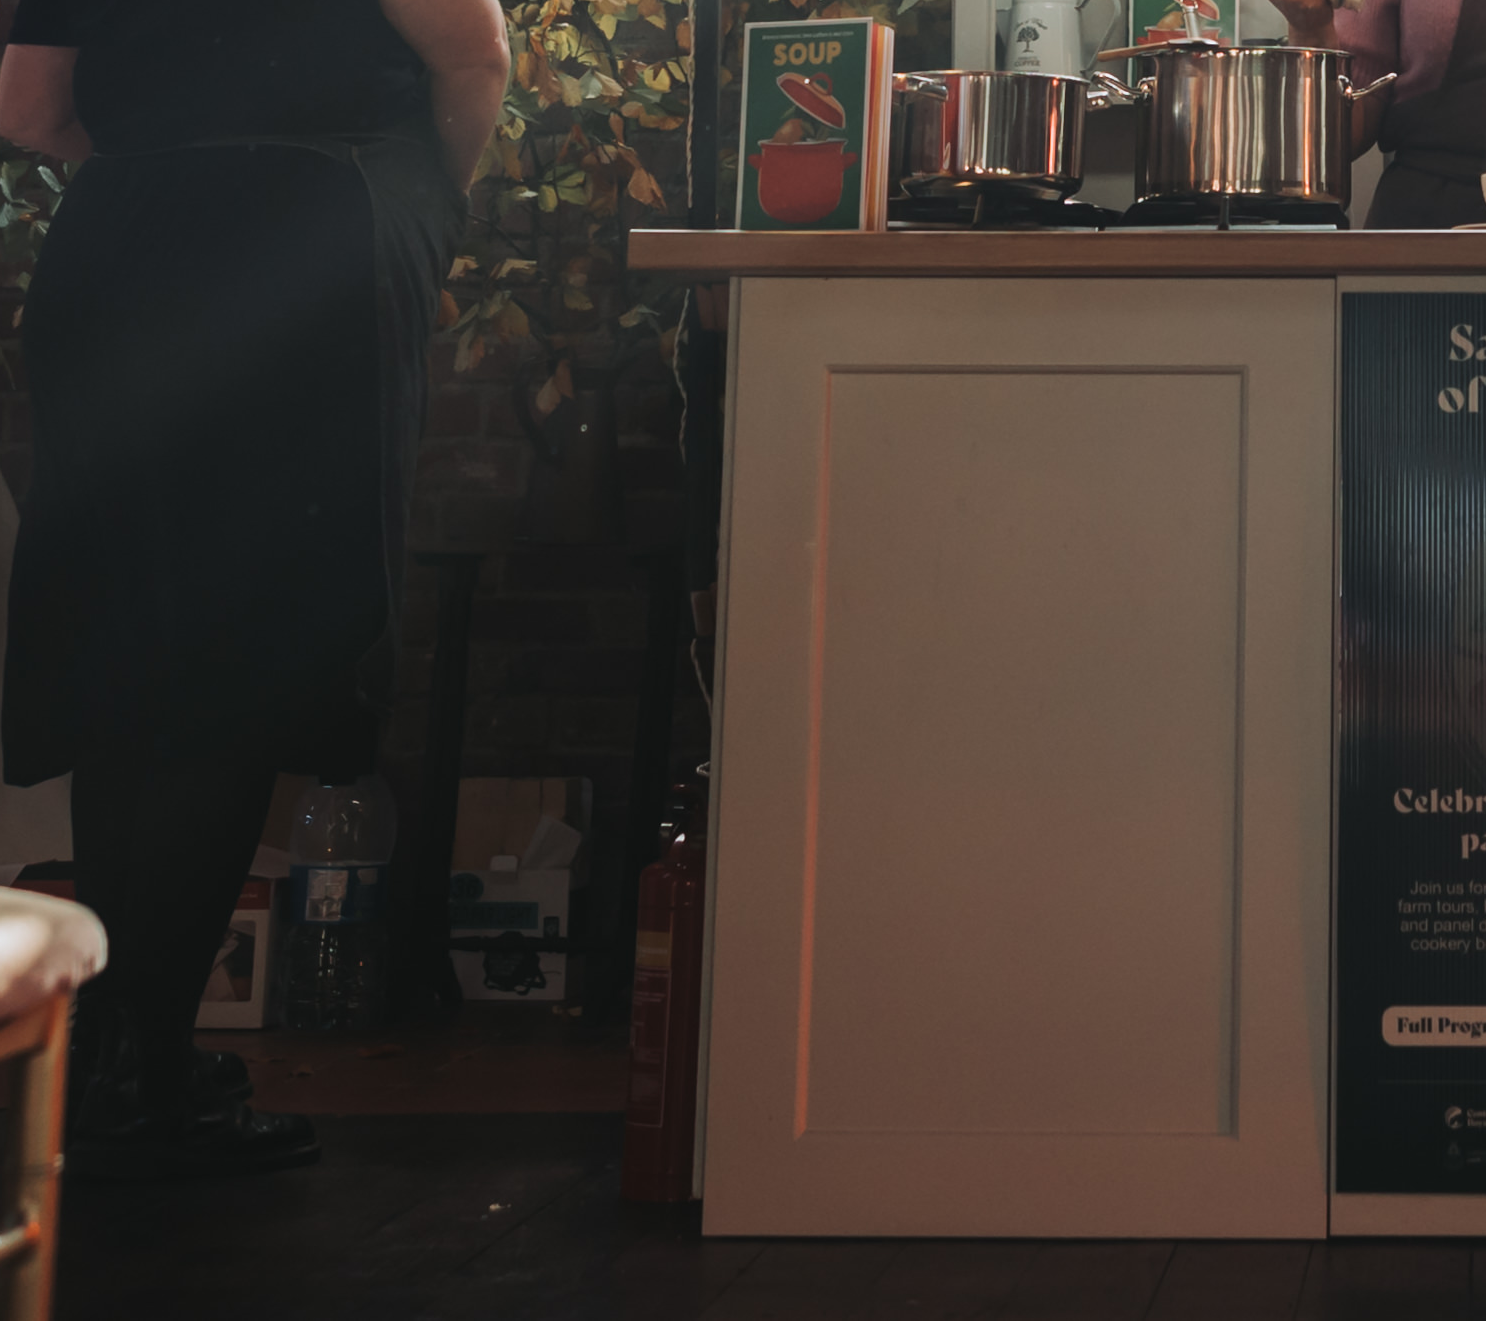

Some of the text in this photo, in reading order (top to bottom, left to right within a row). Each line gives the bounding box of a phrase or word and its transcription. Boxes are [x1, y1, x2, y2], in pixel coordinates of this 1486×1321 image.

[773, 40, 842, 66] SOUP
[1410, 880, 1442, 896] Join
[1446, 884, 1464, 896] us
[1398, 899, 1432, 914] farm
[1436, 900, 1479, 915] tours,
[1400, 918, 1429, 933] and
[1433, 918, 1474, 936] panel
[1410, 938, 1472, 954] cookery
[1397, 1017, 1432, 1034] Full
